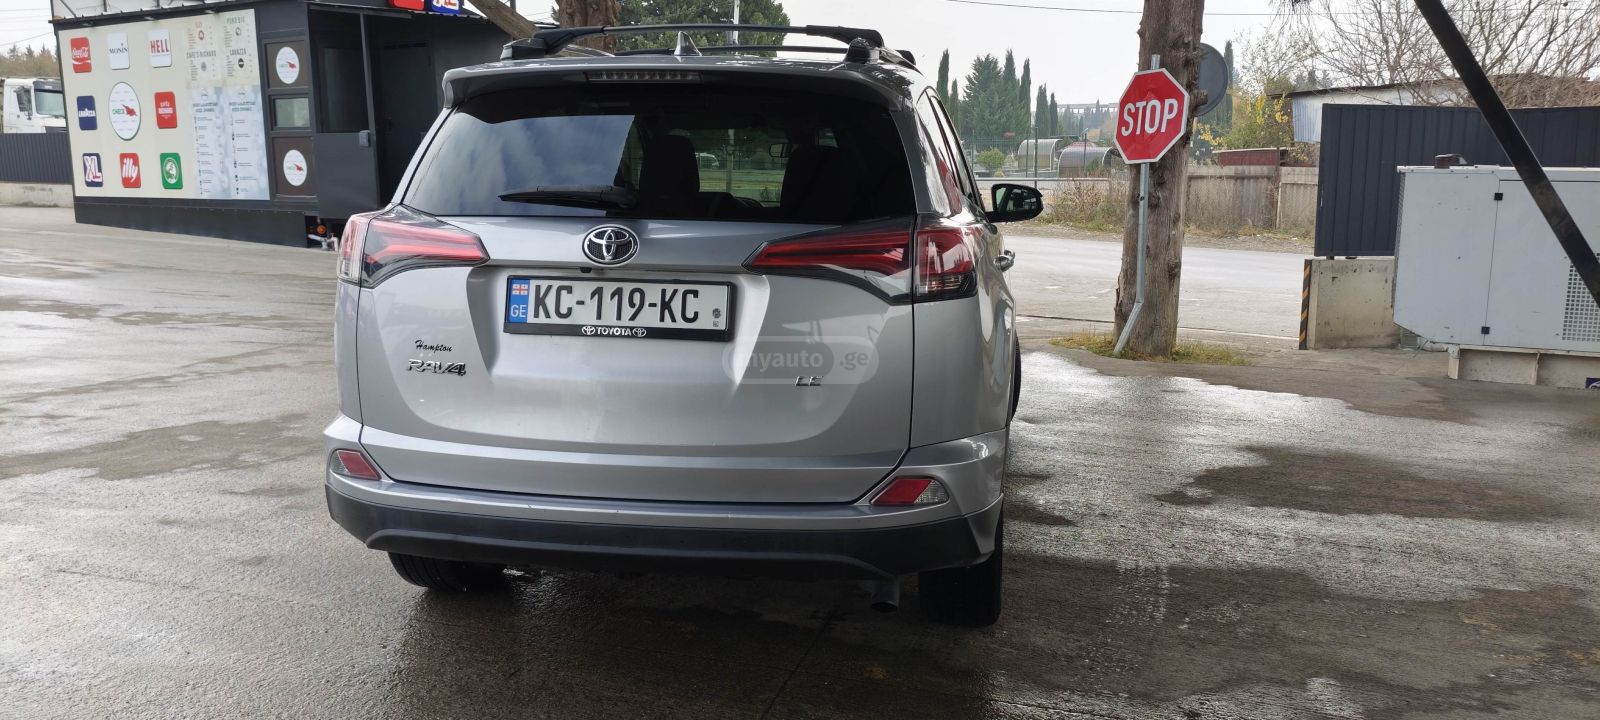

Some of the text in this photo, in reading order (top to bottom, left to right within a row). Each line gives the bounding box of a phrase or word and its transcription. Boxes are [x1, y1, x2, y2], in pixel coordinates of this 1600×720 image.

[109, 47, 128, 55] MONIN
[150, 39, 170, 54] HELL
[1121, 98, 1178, 136] STOP
[84, 156, 102, 182] XL
[122, 157, 139, 183] illy
[510, 304, 527, 318] GE
[533, 284, 699, 324] KC-119-KC
[597, 326, 632, 337] TOYOTA
[415, 339, 453, 353] Hampton
[407, 358, 467, 376] RAV4
[795, 375, 824, 387] LE
